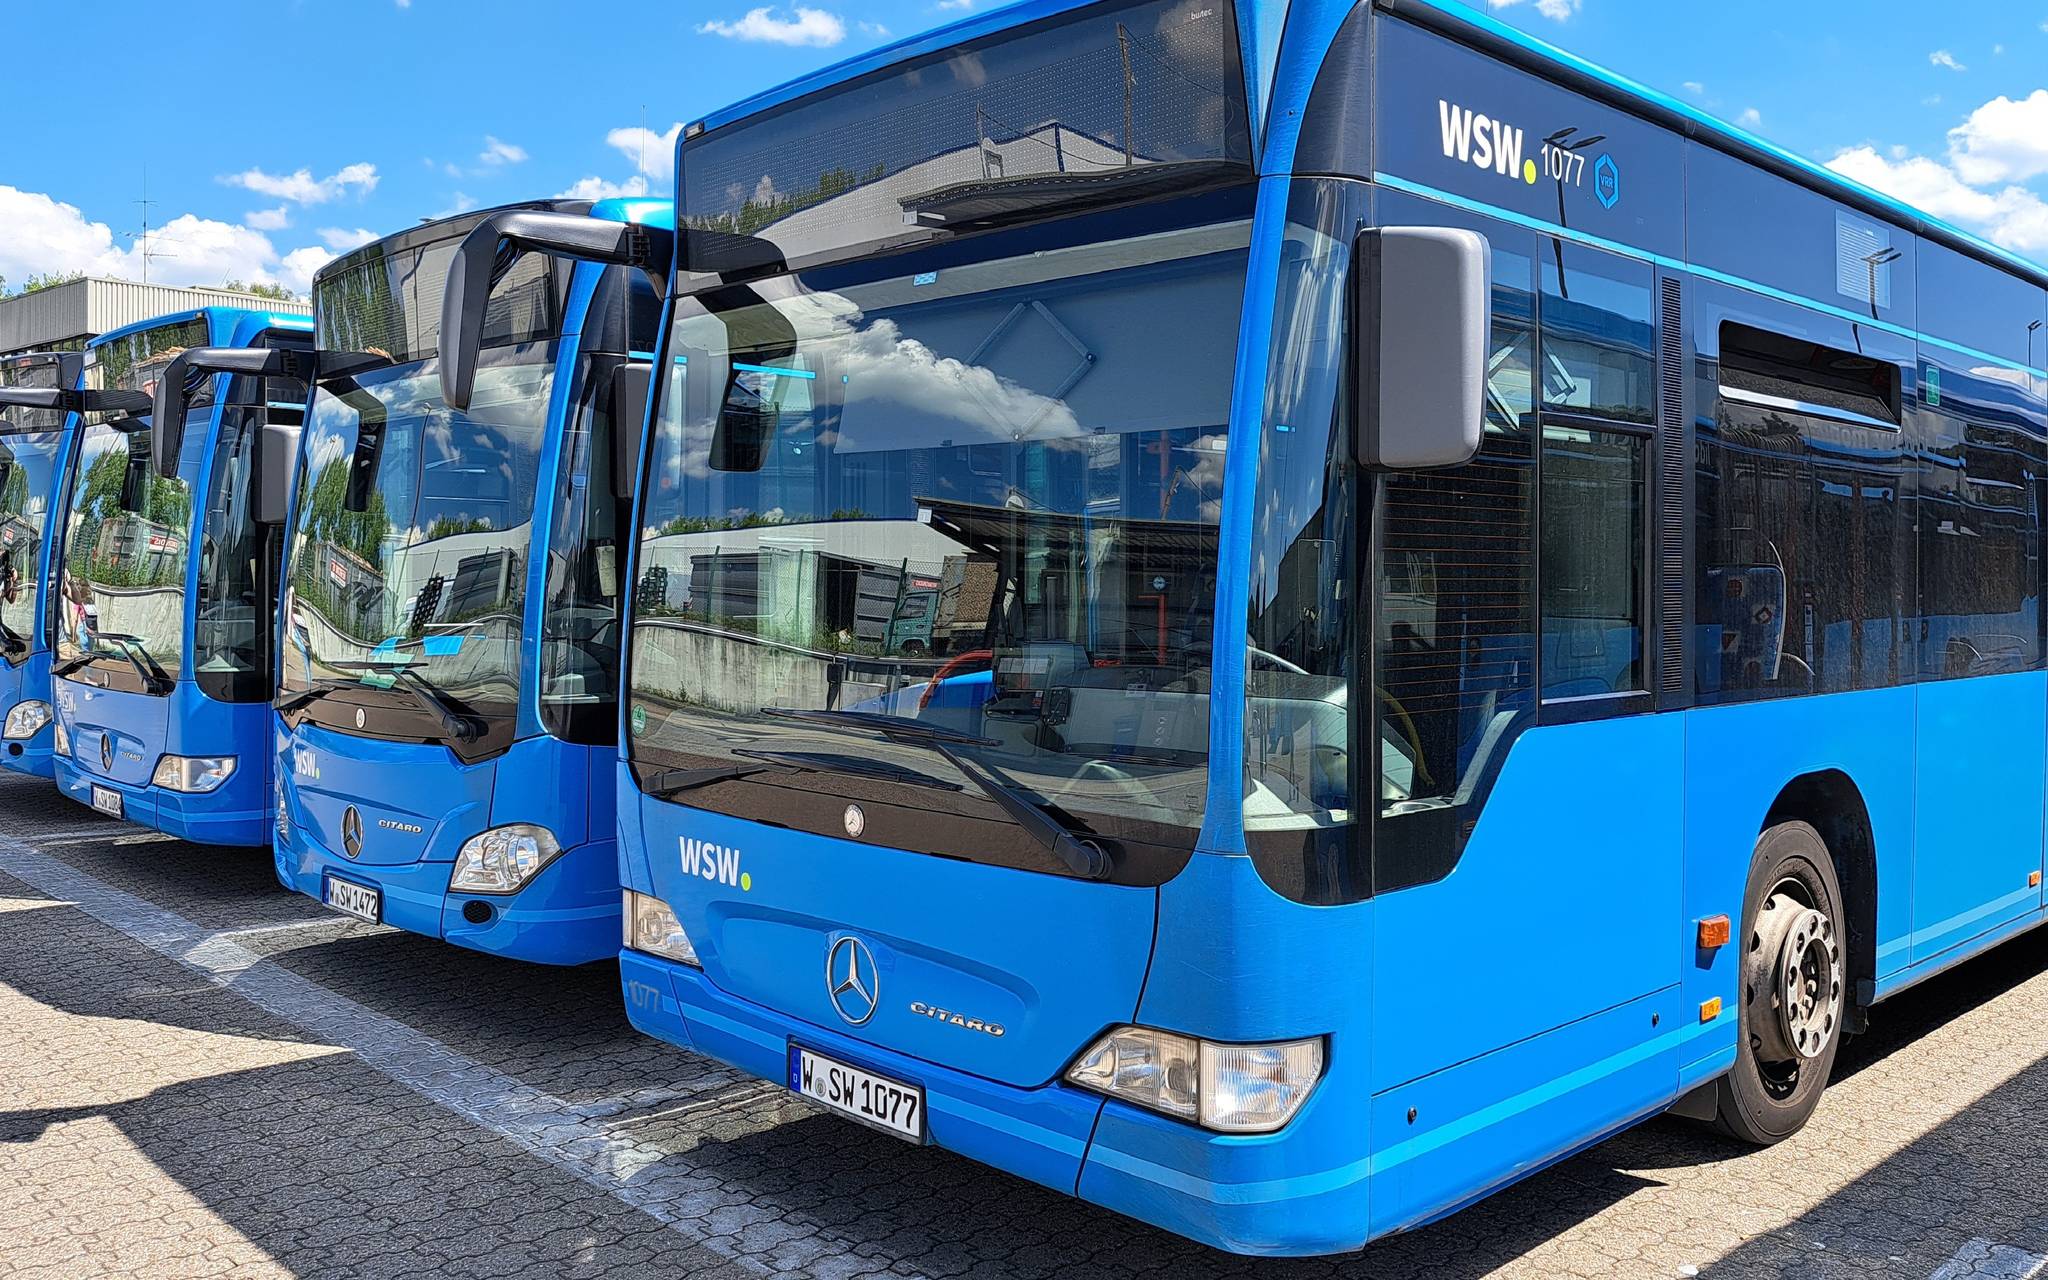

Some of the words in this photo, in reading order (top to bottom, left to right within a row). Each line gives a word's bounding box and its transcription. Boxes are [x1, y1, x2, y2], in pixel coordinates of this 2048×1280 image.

[1541, 143, 1585, 187] 1077
[378, 819, 423, 834] CITARO
[353, 889, 377, 917] 1472
[628, 980, 659, 1013] 1077
[910, 1001, 1005, 1037] CITARO
[860, 1079, 918, 1130] 1077
